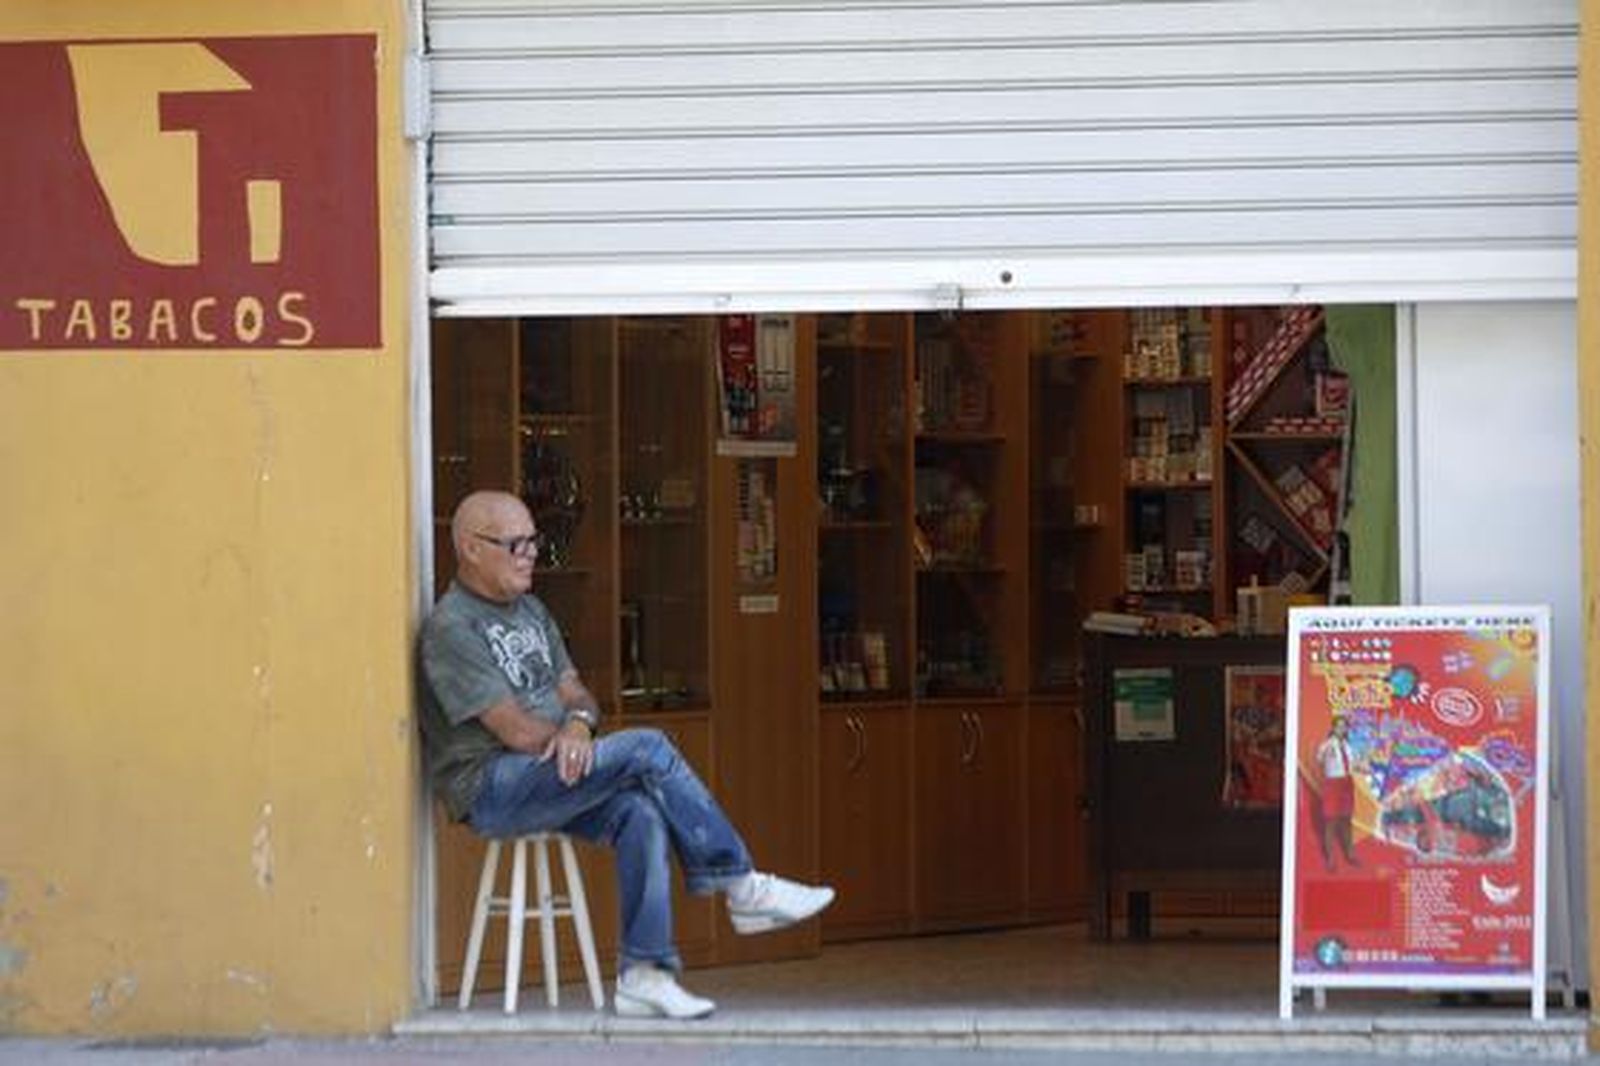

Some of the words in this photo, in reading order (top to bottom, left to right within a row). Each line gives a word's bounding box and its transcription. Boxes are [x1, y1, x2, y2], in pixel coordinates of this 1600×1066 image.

[16, 292, 314, 346] TABACOS
[1371, 615, 1467, 628] TICKETS
[1474, 614, 1537, 626] HERE
